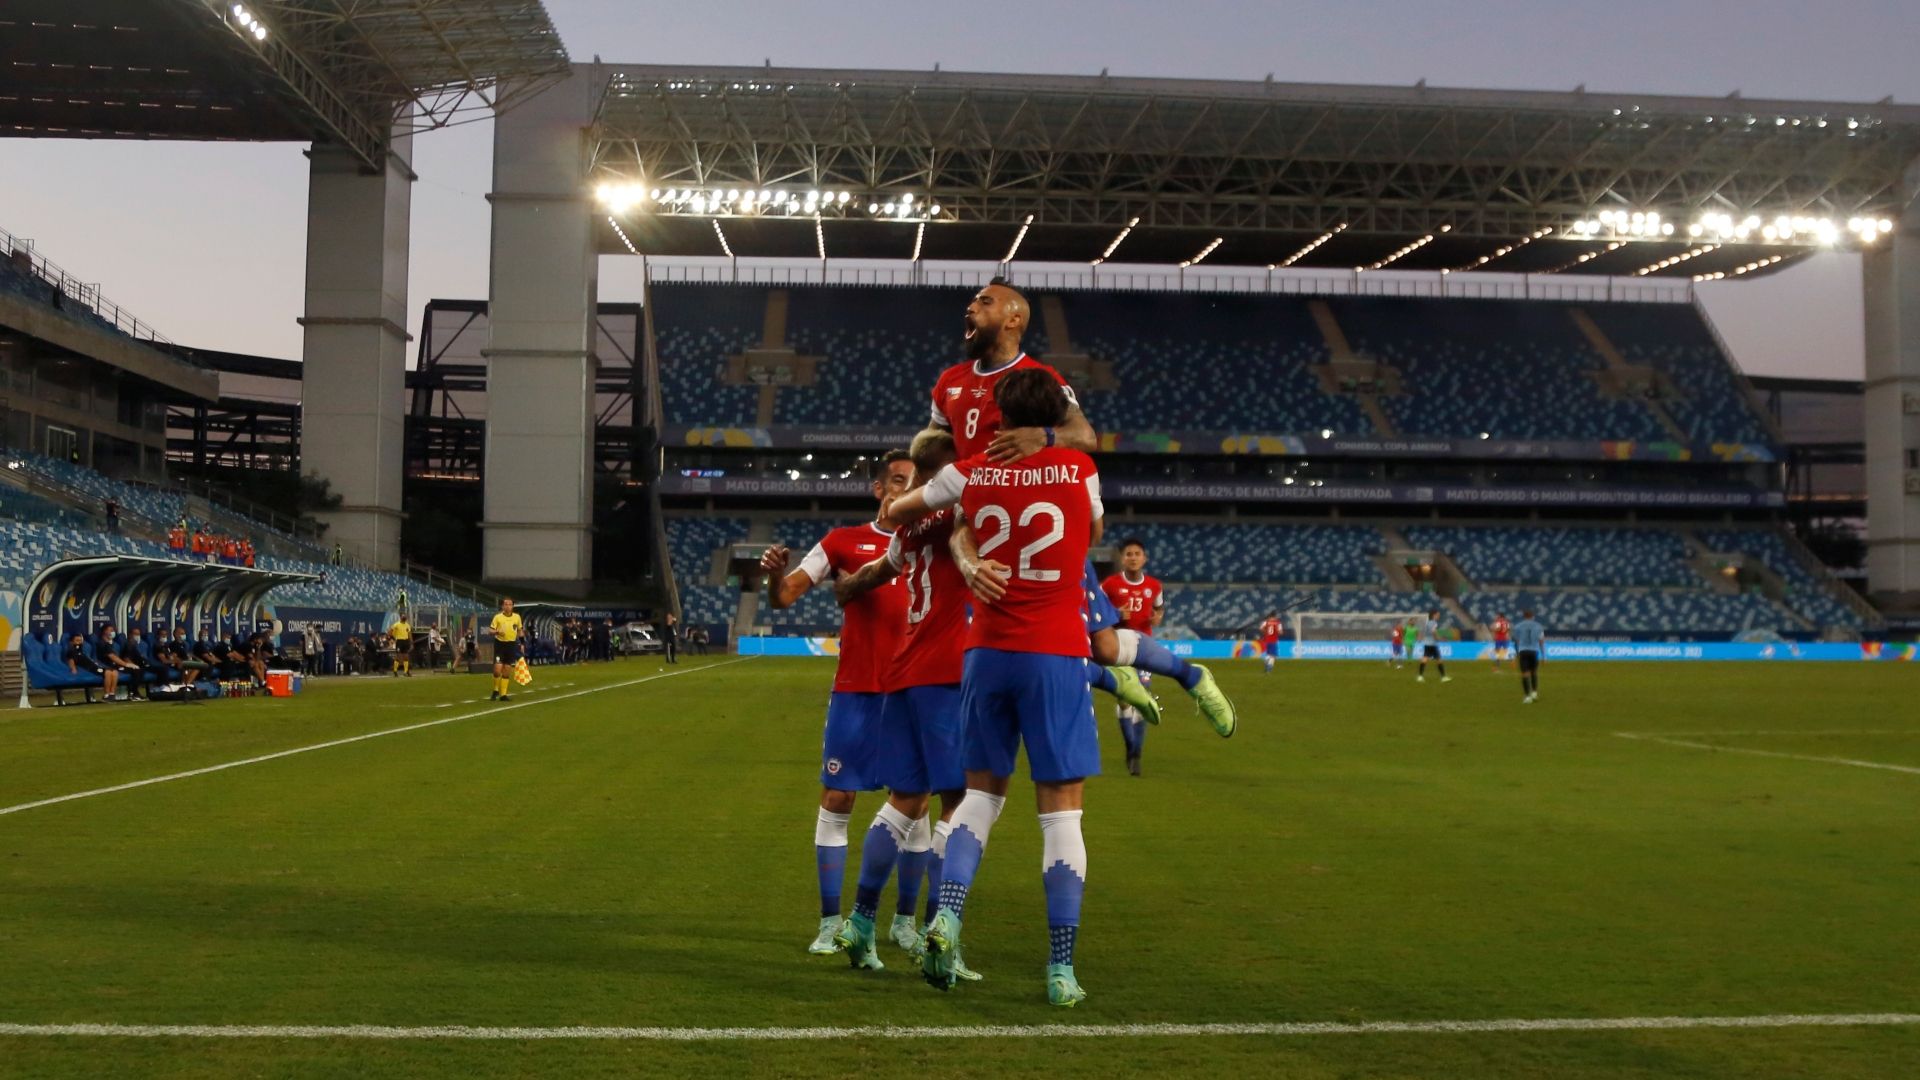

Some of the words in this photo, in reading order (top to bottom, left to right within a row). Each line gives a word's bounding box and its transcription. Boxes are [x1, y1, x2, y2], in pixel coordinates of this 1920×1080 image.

[966, 408, 980, 439] 8
[802, 434, 852, 443] CONMEBOL
[854, 435, 879, 443] COPA
[968, 467, 1042, 487] BRERETON
[1045, 464, 1080, 485] DIAZ
[726, 481, 761, 492] MATO
[827, 481, 866, 492] MAIOR
[1121, 485, 1154, 497] MATO
[1235, 486, 1251, 497] DE
[1253, 487, 1314, 498] NATUREZA
[1317, 487, 1393, 499] PRESERVADA
[1446, 490, 1479, 500] MATO
[975, 501, 1065, 582] 22
[1128, 597, 1143, 612] 13
[1547, 646, 1605, 657] CONMEBOL
[1607, 646, 1634, 657] COPA
[1636, 646, 1682, 657] AMERICA
